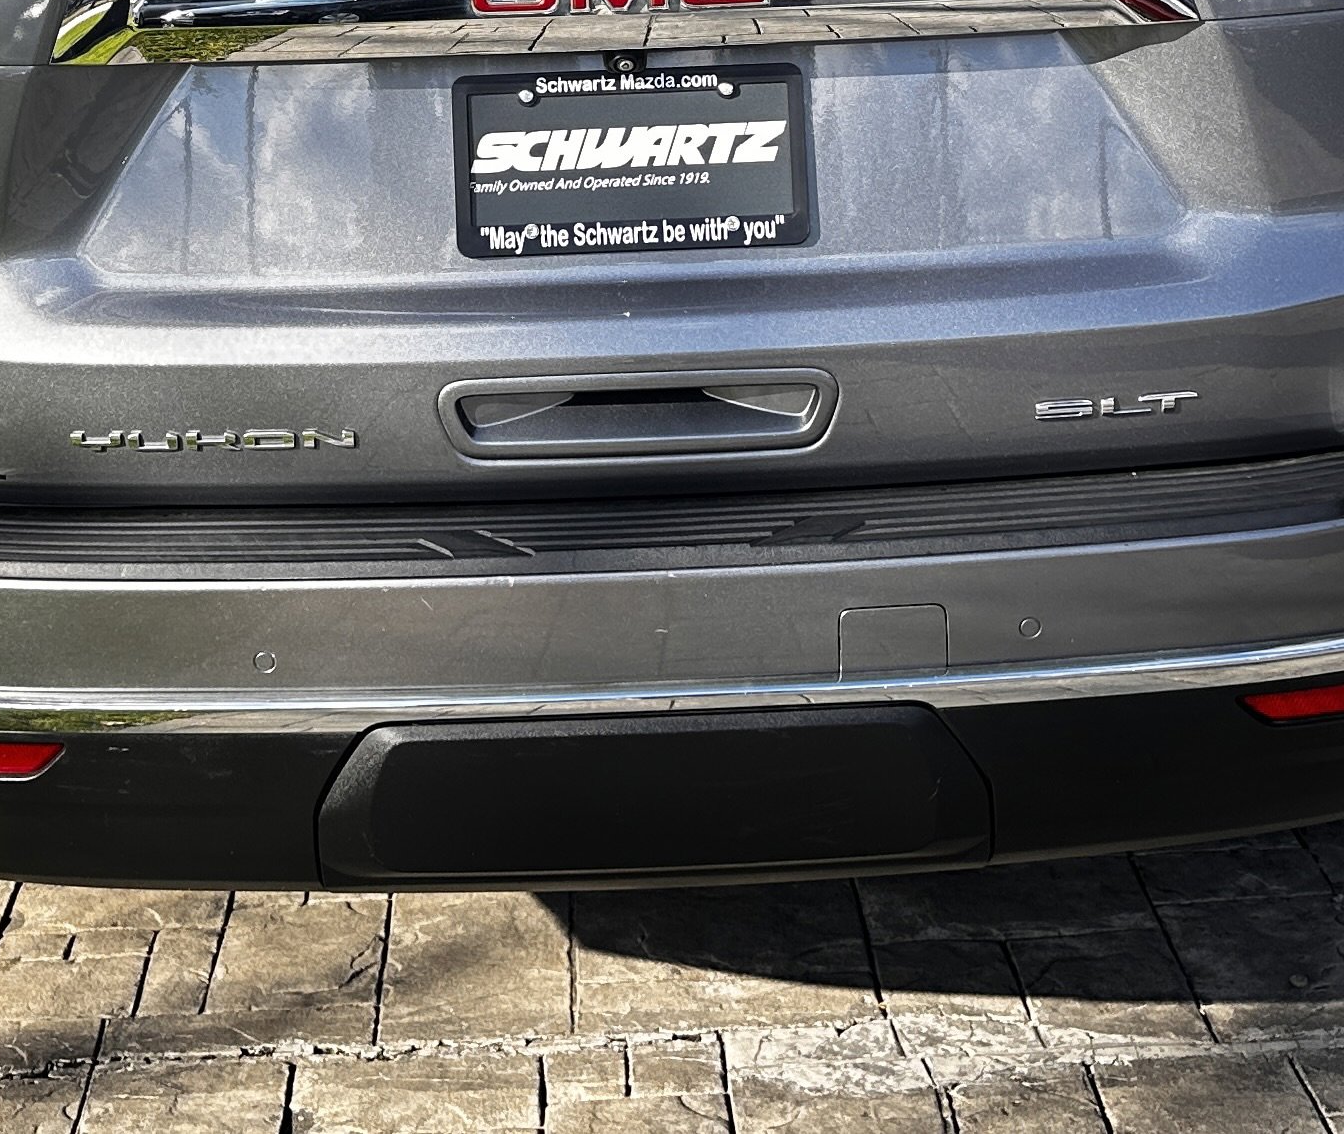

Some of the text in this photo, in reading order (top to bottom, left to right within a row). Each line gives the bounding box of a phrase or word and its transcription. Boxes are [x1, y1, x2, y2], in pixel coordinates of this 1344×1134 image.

[535, 73, 718, 94] Schwartz Mazda.com
[470, 120, 788, 174] SCHWARTZ
[508, 177, 555, 192] Owned
[555, 176, 583, 190] And
[583, 174, 643, 191] Operated
[642, 173, 676, 186] Since
[679, 171, 710, 185] 1919.
[480, 214, 785, 255] "May the Schwartz be with you"
[1035, 391, 1198, 420] SLT
[69, 429, 356, 452] YUKON
